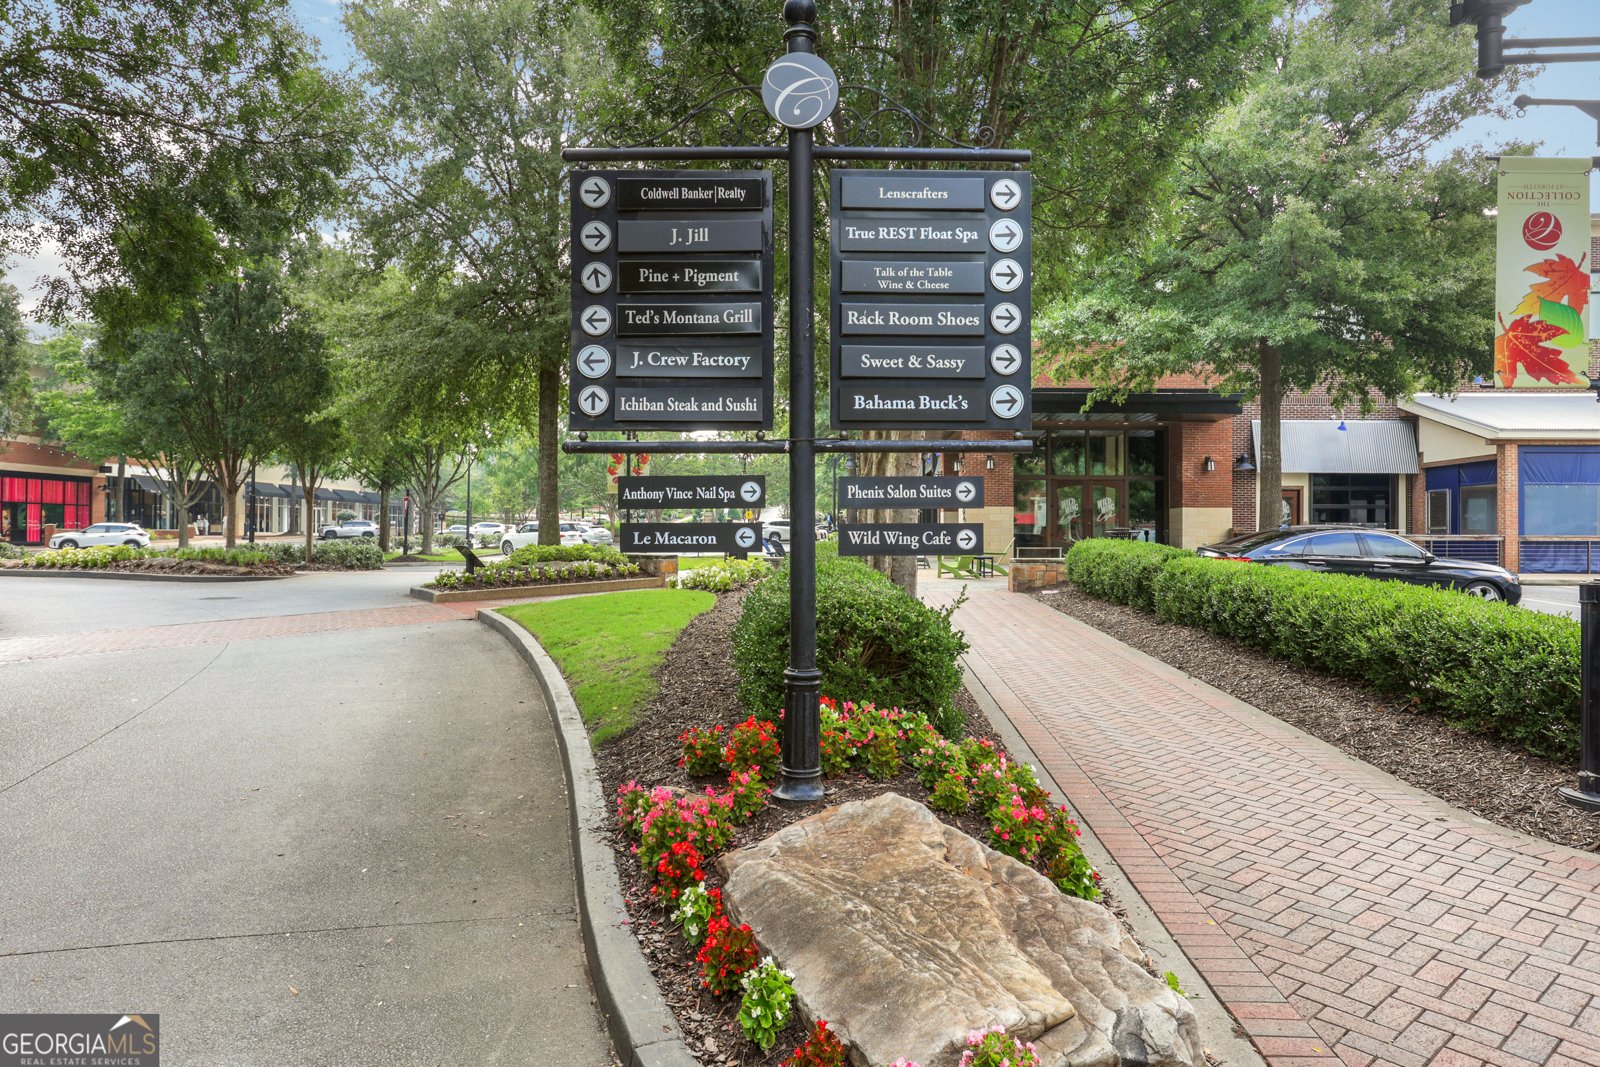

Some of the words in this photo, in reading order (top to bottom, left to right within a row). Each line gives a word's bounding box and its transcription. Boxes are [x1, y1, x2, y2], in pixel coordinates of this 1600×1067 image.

[641, 188, 679, 199] Coldwell
[682, 188, 713, 198] Banker
[718, 187, 746, 201] Realty
[880, 187, 948, 198] Lenscrafters
[670, 229, 682, 245] J.
[686, 228, 709, 245] Jill
[846, 227, 875, 238] True
[879, 228, 917, 239] REST
[920, 227, 952, 239] Float
[955, 228, 978, 243] Spa
[639, 269, 668, 282] Pine
[673, 273, 680, 281] +
[684, 269, 739, 286] Pigment
[874, 268, 895, 276] Talk
[898, 267, 908, 276] of
[910, 268, 924, 276] the
[927, 268, 952, 276] Table
[878, 280, 903, 288] Wine
[917, 280, 949, 289] Cheese
[626, 310, 659, 324] Ted's
[663, 309, 720, 323] Montana
[723, 309, 752, 323] Grill
[848, 310, 884, 324] Rack
[889, 312, 932, 325] Room
[937, 312, 979, 325] Shoes
[630, 352, 643, 369] J.
[648, 352, 689, 365] Crew
[692, 352, 750, 370] Factory
[861, 354, 903, 367] Sweet
[908, 355, 922, 368] &
[927, 355, 965, 372] Sassy
[621, 397, 664, 411] Ichiban
[667, 397, 699, 411] Steak
[702, 397, 723, 411] and
[726, 397, 757, 411] Sushi
[854, 395, 915, 409] Bahama
[919, 395, 968, 409] Buck's
[623, 487, 664, 503] Anthony
[666, 488, 693, 499] Vince
[696, 486, 716, 498] Nail
[718, 487, 735, 502] Spa
[848, 485, 884, 498] Phenix
[887, 484, 917, 498] Salon
[920, 485, 951, 498] Suites
[633, 532, 651, 544] Le
[654, 532, 717, 544] Macaron
[848, 531, 880, 544] Wild
[883, 531, 919, 549] Wing
[923, 531, 951, 544] Cafe
